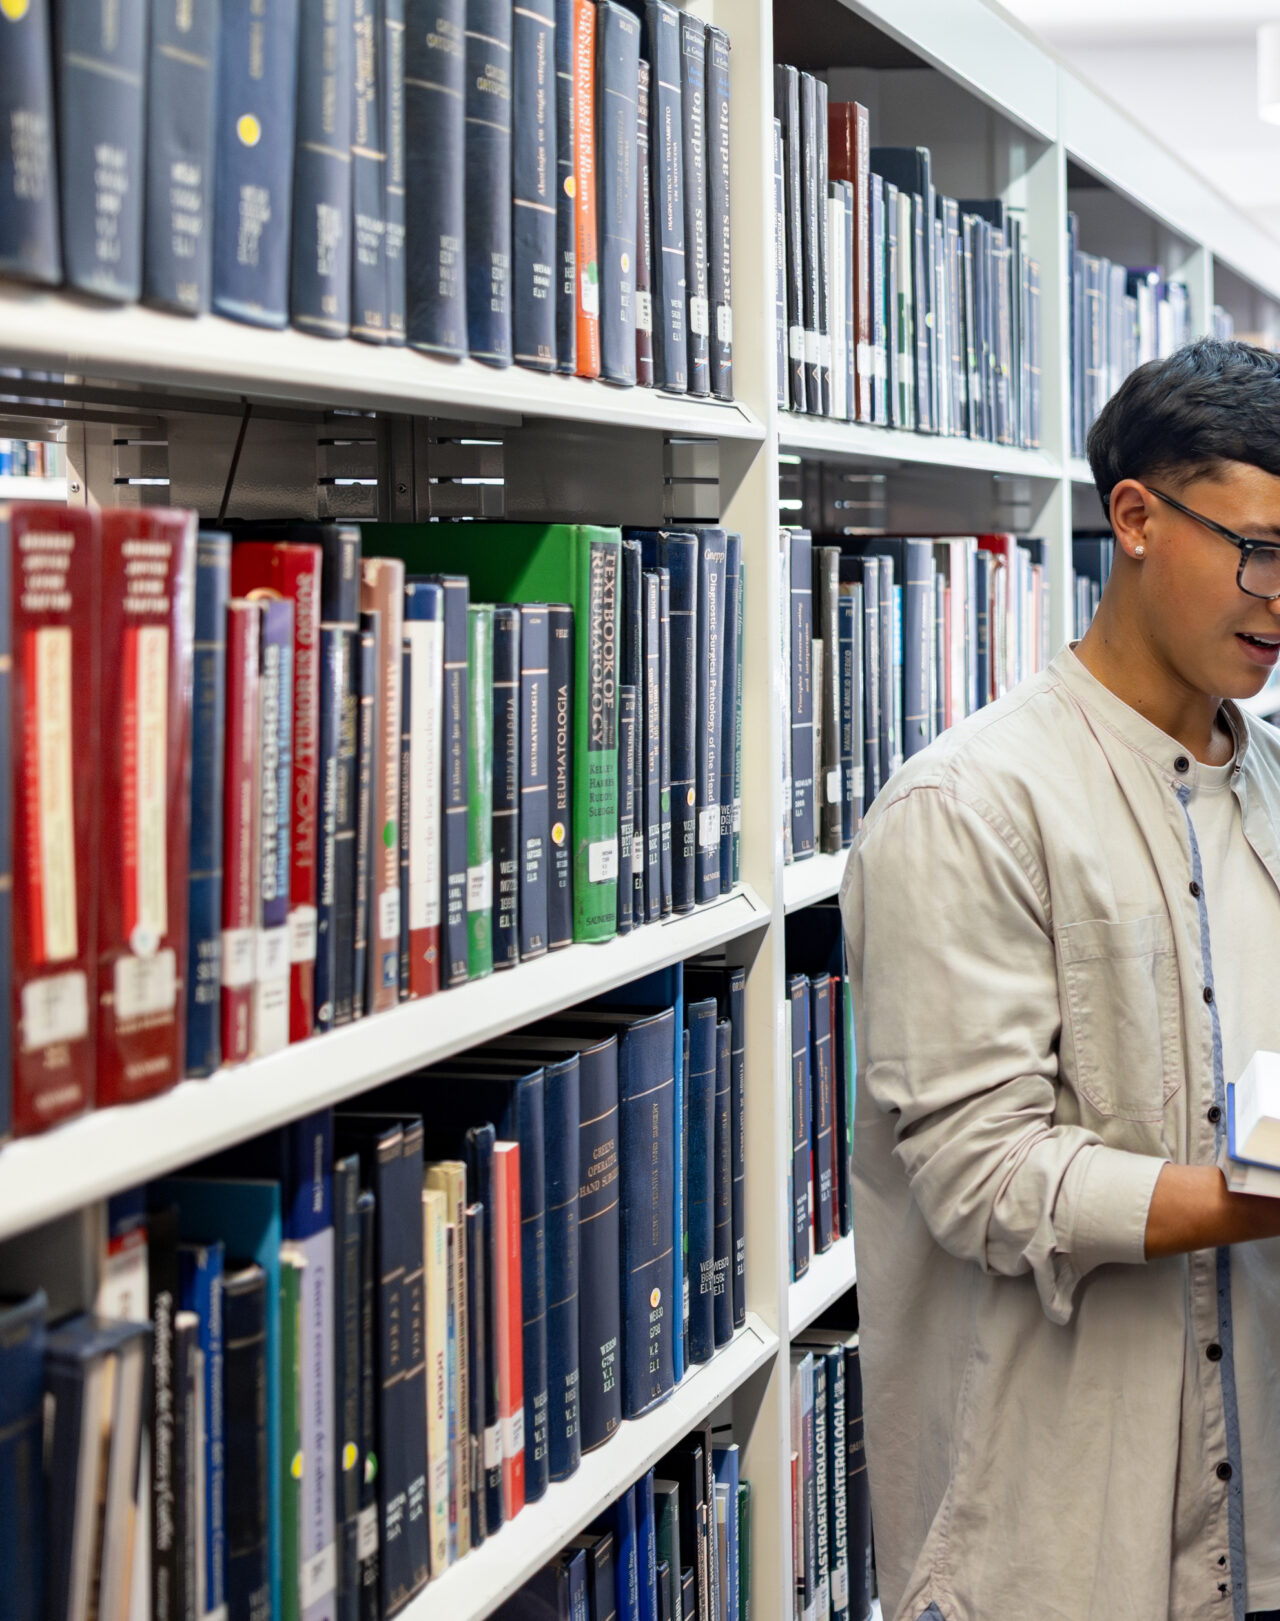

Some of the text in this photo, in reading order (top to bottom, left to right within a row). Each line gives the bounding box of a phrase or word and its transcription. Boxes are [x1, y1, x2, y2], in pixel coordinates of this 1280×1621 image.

[602, 551, 617, 676] TEXTBOOK
[707, 572, 718, 633] Diagnostic
[591, 550, 606, 745] RHEUMATOLOGY
[707, 633, 718, 677] Surgical
[602, 678, 614, 709] OF
[707, 679, 717, 734] Pathology
[556, 684, 568, 810] REUMATOLOGIA
[579, 1180, 601, 1198] HAND
[706, 1452, 714, 1497] GLOBAL
[815, 1414, 829, 1588] GASTROENTEROLOGIA
[833, 1399, 848, 1571] GASTROENTEROLOGIA
